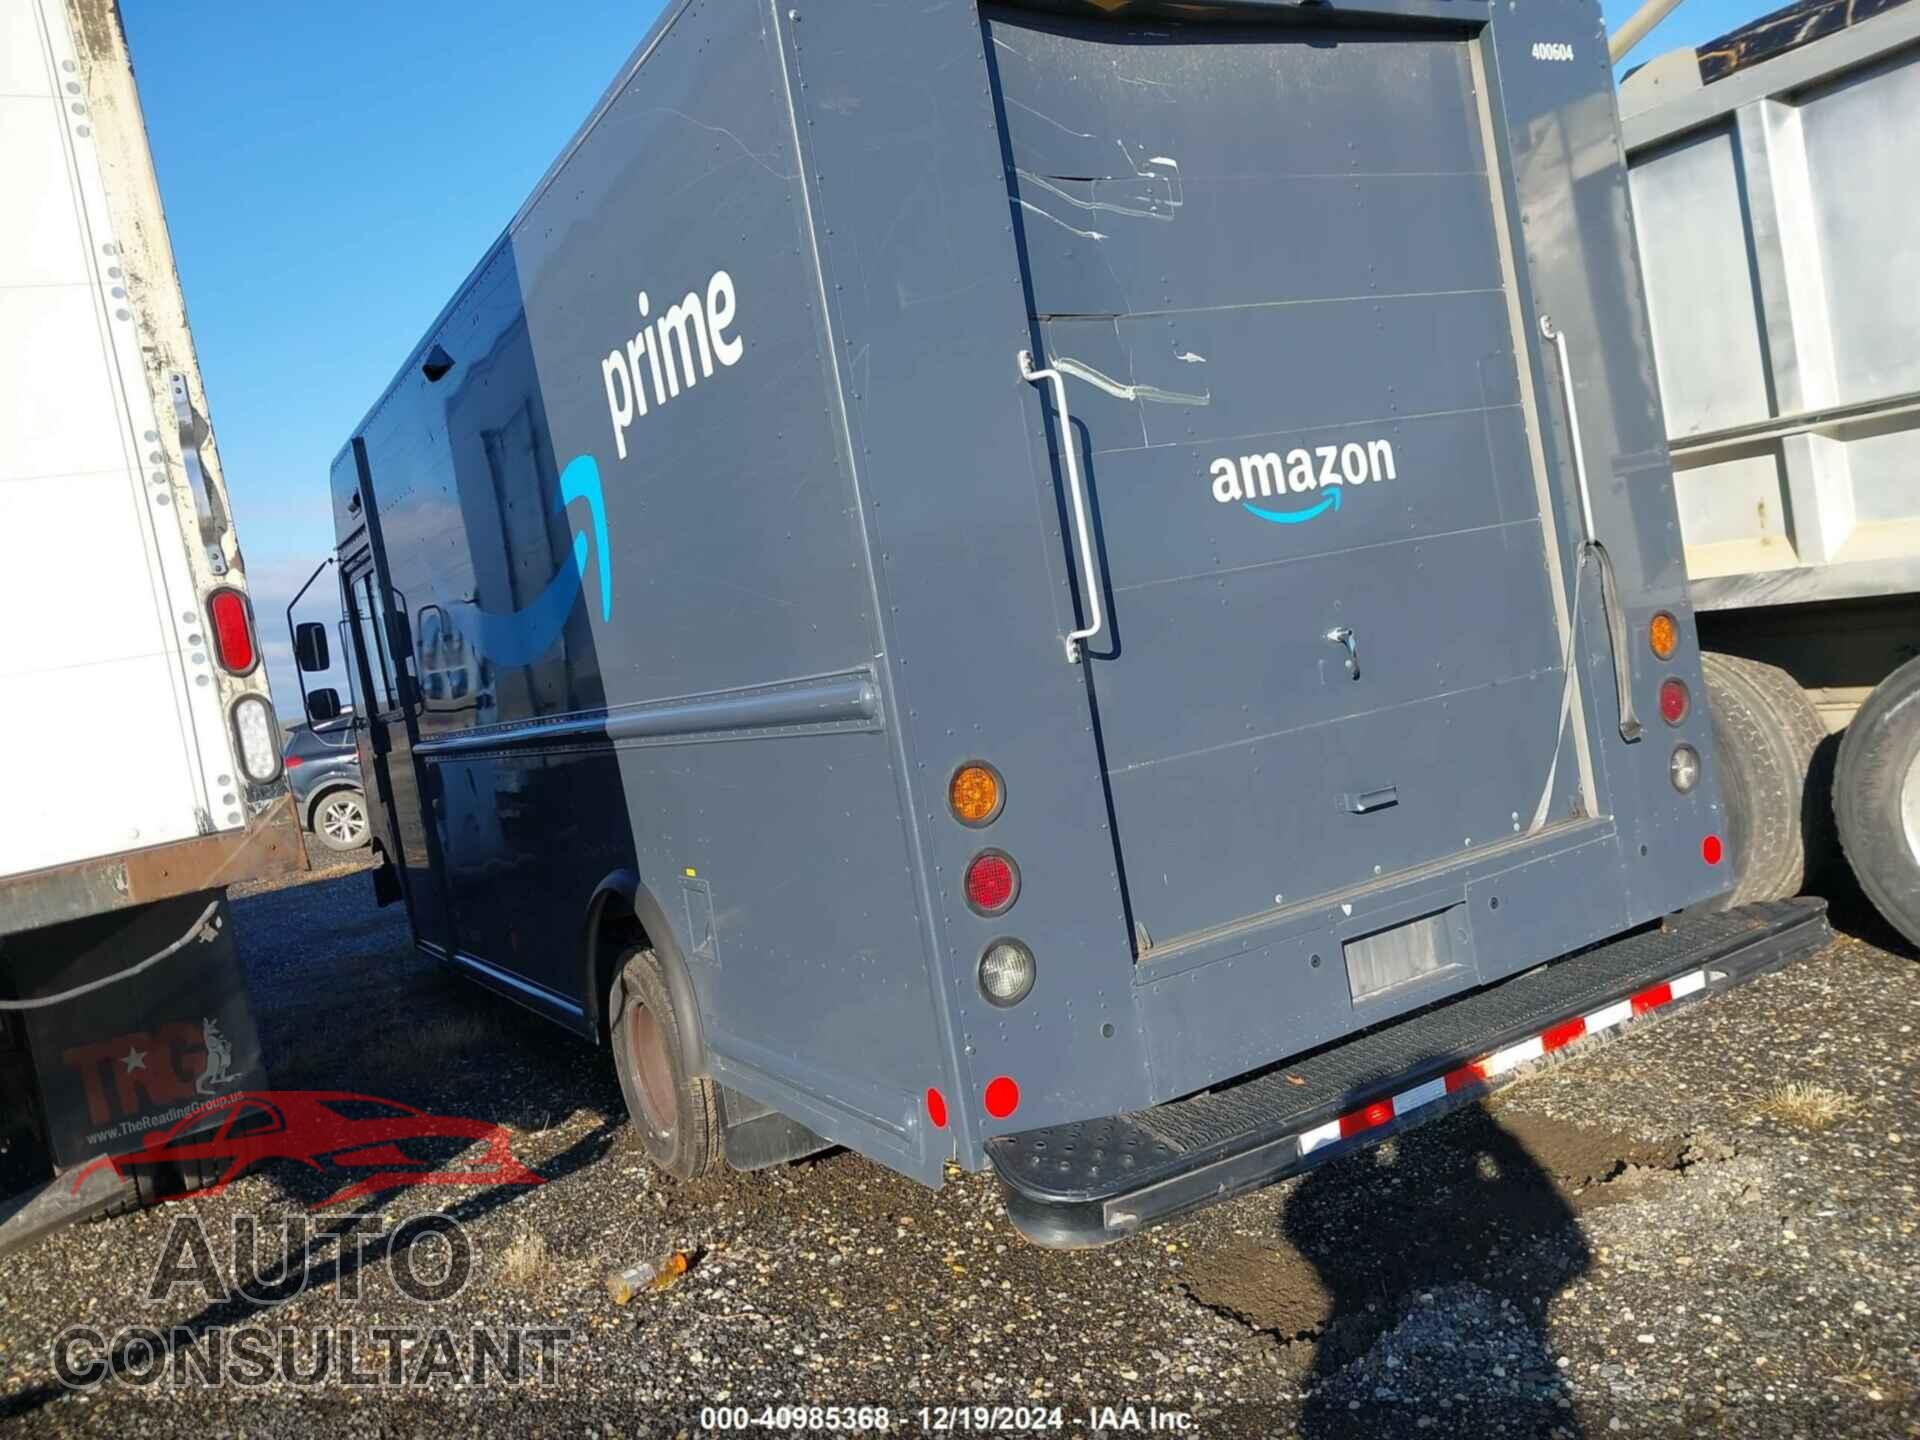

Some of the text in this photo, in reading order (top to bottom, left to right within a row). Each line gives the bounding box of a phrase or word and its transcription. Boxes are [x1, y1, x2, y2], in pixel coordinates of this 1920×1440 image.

[1531, 42, 1574, 61] 400604
[601, 270, 743, 460] prime
[1209, 439, 1397, 503] amazon
[63, 1022, 209, 1126] TRG
[86, 1089, 245, 1145] www.TheReadingGroup.us
